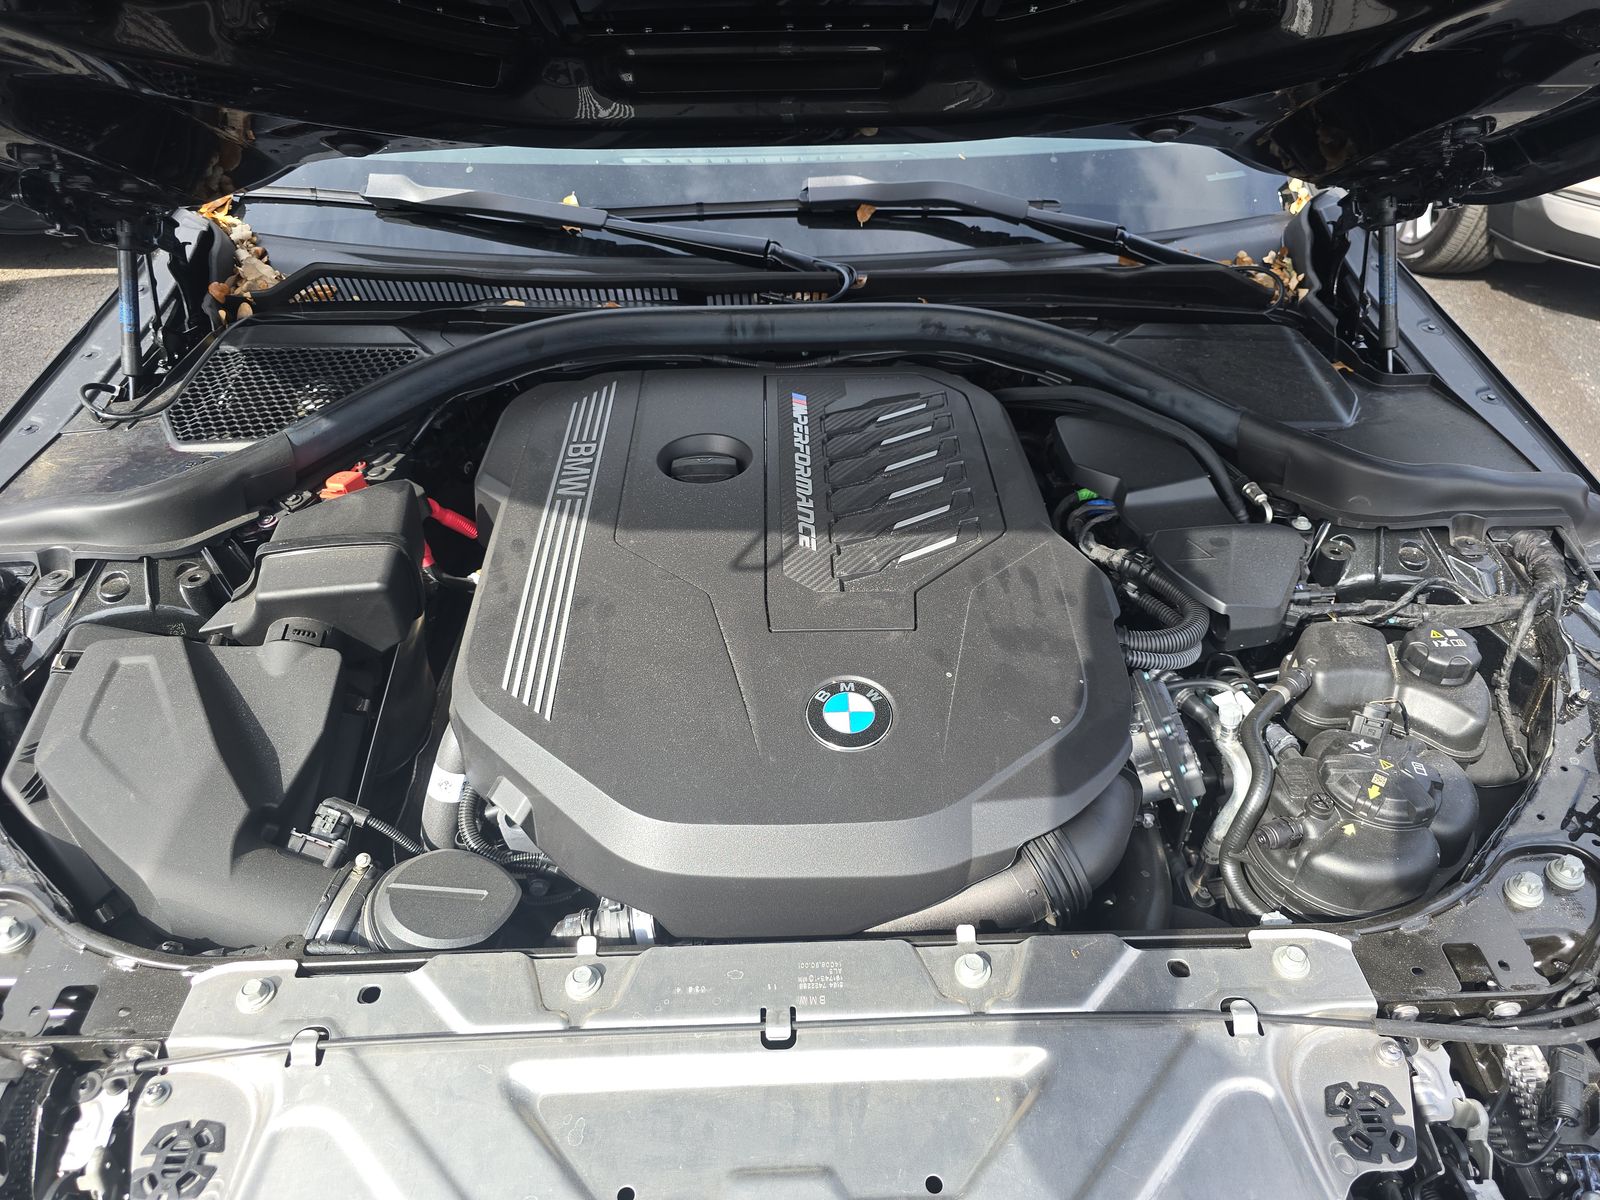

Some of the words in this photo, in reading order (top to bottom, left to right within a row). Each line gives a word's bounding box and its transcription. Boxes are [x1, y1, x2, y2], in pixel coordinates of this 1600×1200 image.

[556, 443, 597, 496] BMW
[814, 682, 883, 703] BMW
[799, 995, 826, 1005] BMW
